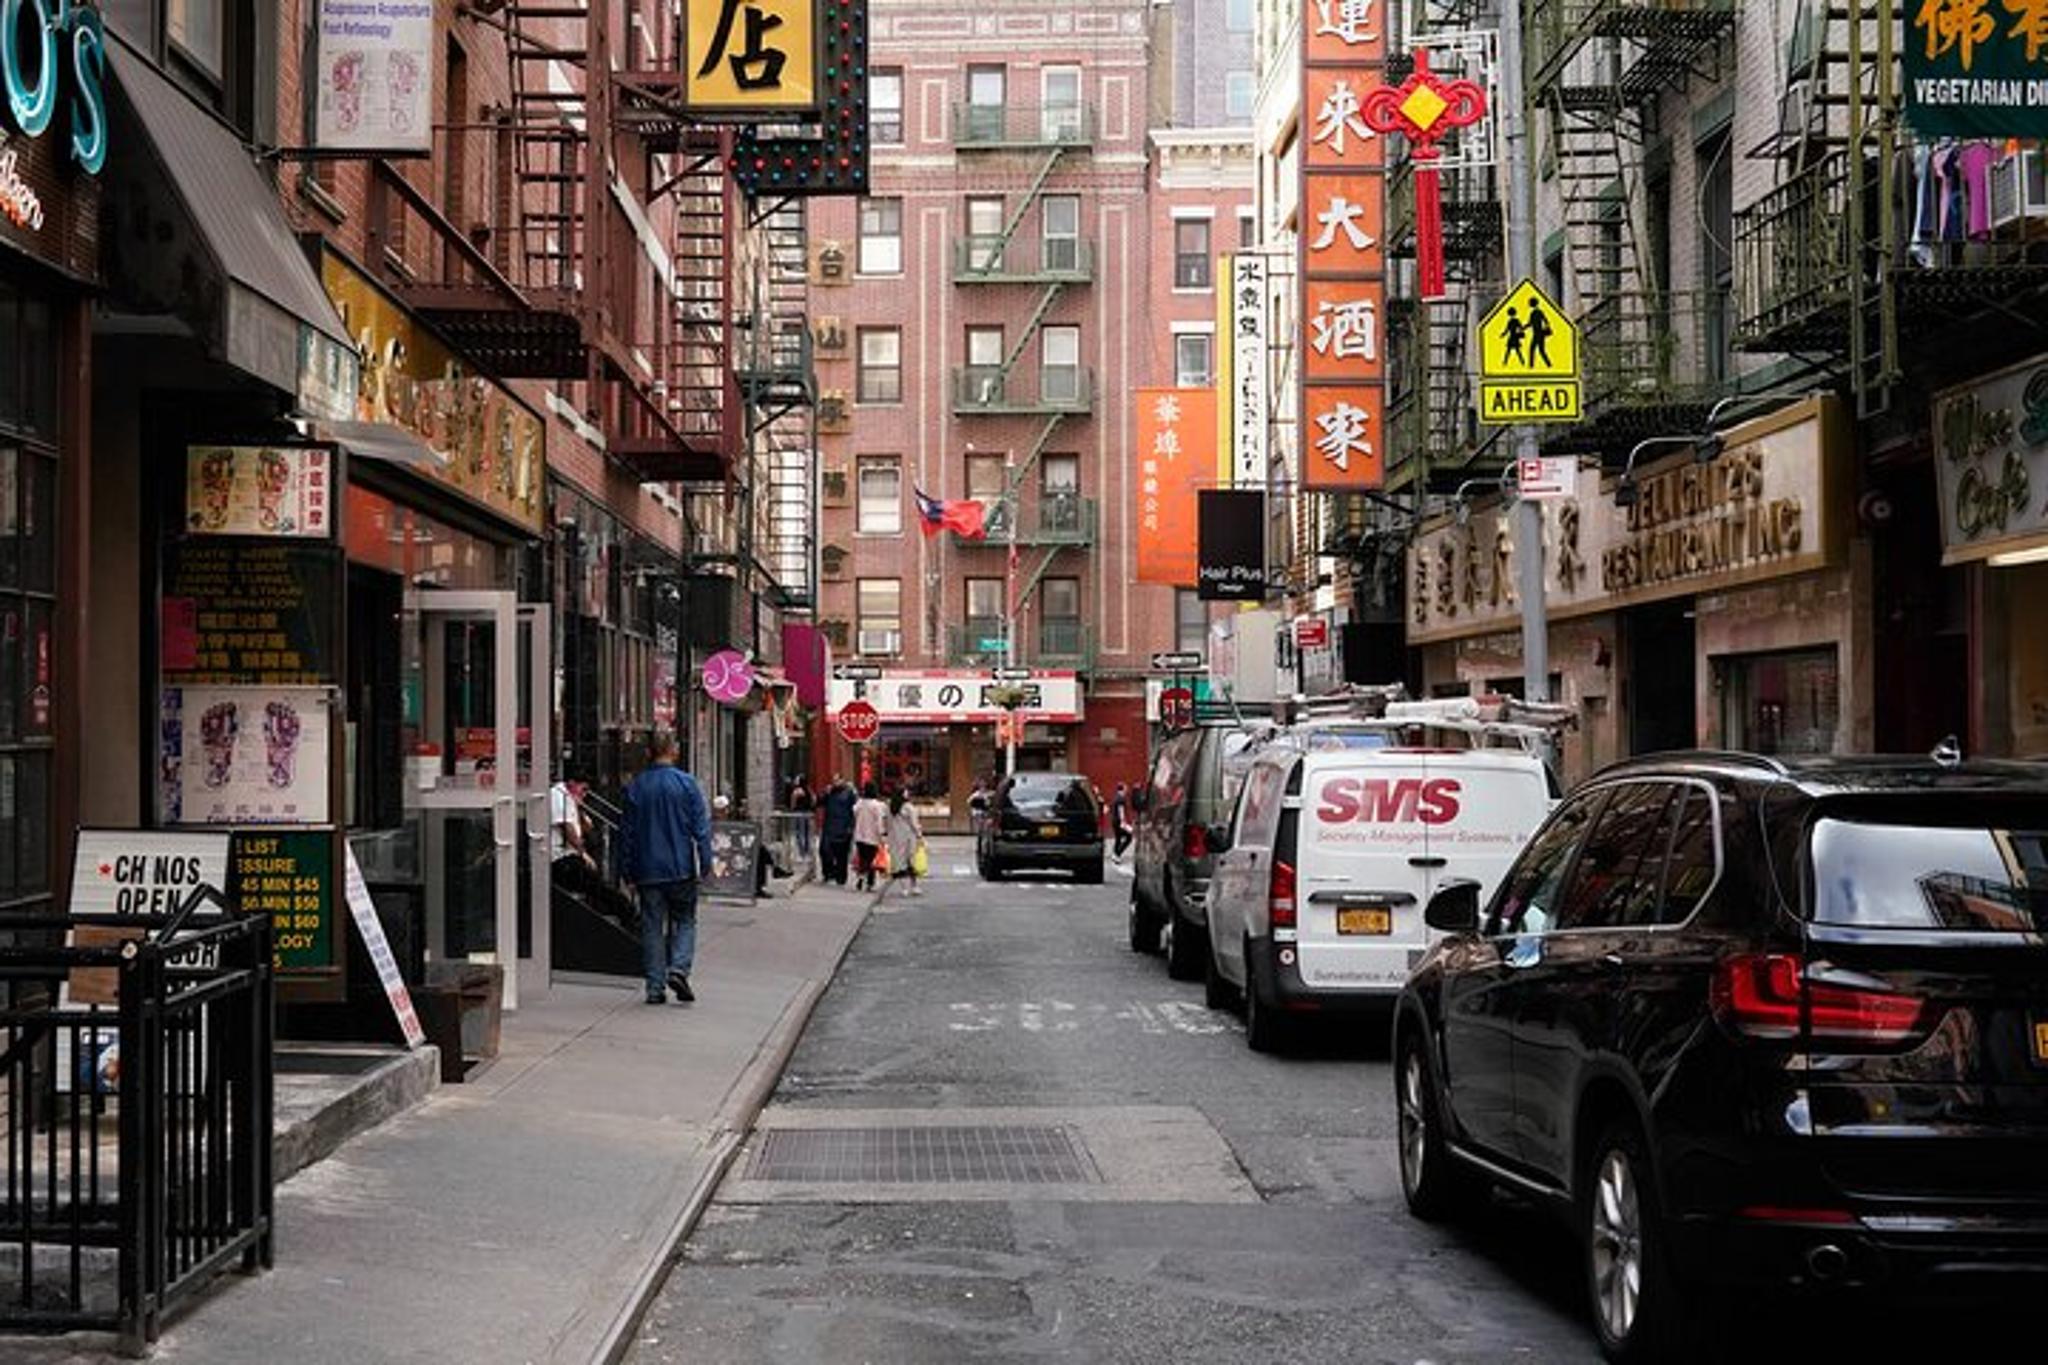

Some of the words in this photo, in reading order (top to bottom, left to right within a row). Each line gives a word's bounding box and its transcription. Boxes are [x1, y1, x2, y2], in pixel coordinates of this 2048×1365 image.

[696, 0, 788, 91] 店
[1914, 78, 2023, 106] VEGETARIAN
[1492, 389, 1570, 413] AHEAD
[1200, 566, 1230, 581] Hair
[1231, 566, 1263, 582] Plus
[840, 713, 875, 729] STOP
[1316, 779, 1463, 824] SMS
[1316, 829, 1367, 844] Security
[1371, 829, 1455, 844] Management
[244, 839, 279, 854] LIST
[261, 877, 291, 891] MIN
[116, 887, 183, 914] OPEN
[261, 895, 291, 910] MIN
